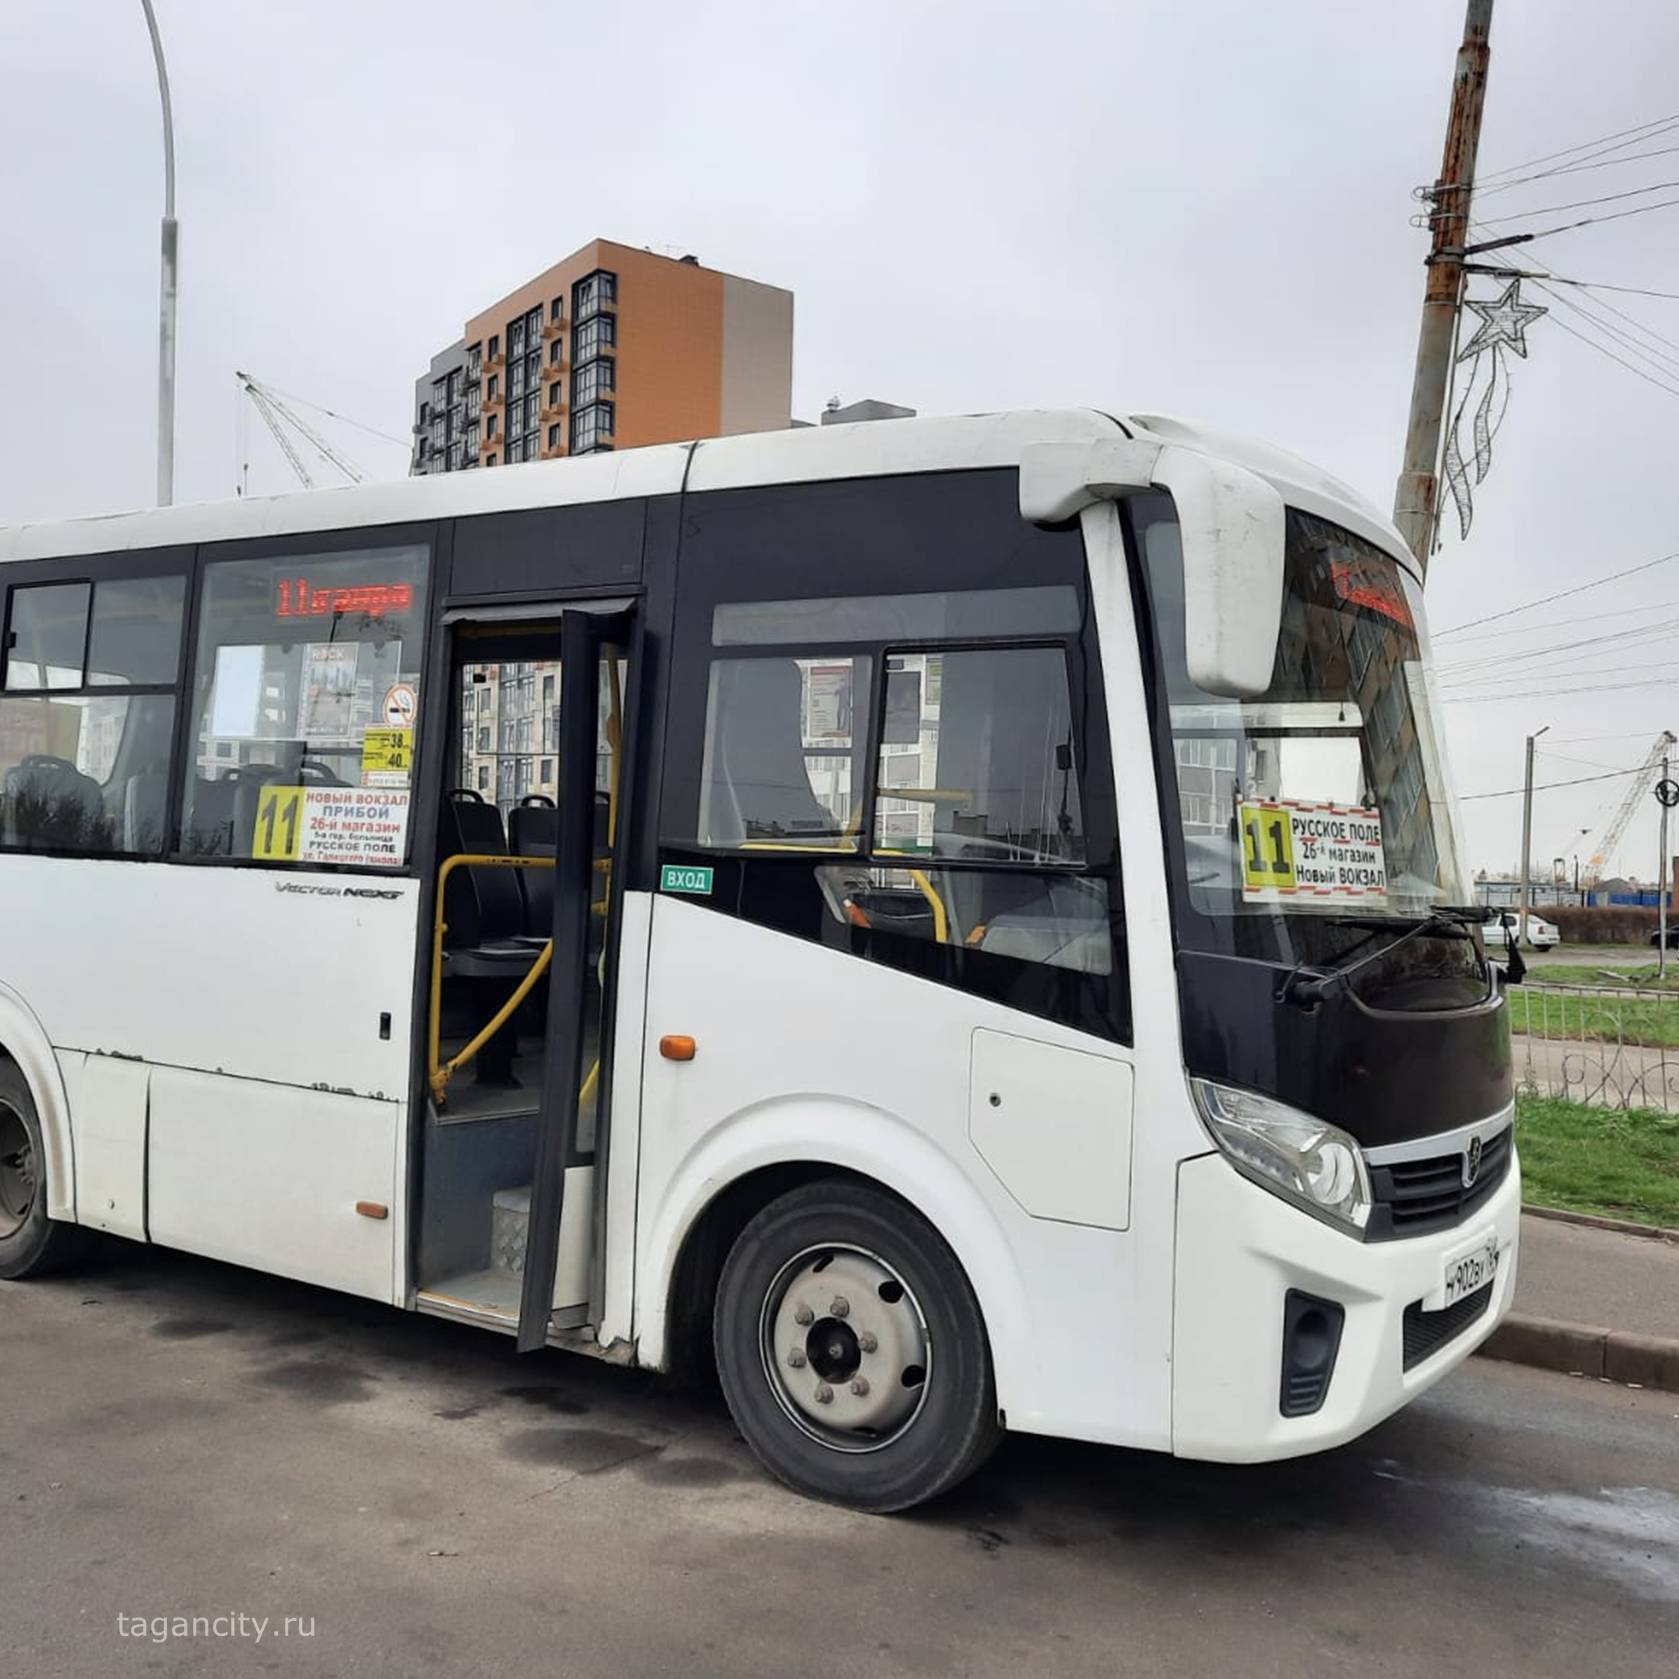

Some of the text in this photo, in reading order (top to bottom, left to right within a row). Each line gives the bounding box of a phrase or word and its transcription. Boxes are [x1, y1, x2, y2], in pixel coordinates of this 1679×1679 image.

[391, 733, 403, 748] 38
[388, 753, 402, 768] 40
[306, 792, 408, 806] НОВЫЙ ВОКЗАЛ
[323, 806, 389, 819] ПРИБОЙ
[261, 793, 299, 854] 11
[310, 817, 401, 833] 26-й магазин
[1292, 818, 1380, 842] РУССКОЕ ПОЛЕ
[309, 841, 396, 853] РУССКОЕ ПОЛЕ
[1246, 818, 1290, 874] 11
[1329, 848, 1376, 863] магазин
[667, 870, 706, 889] ВХОД
[1296, 864, 1385, 887] Новый ВОКЗАЛ
